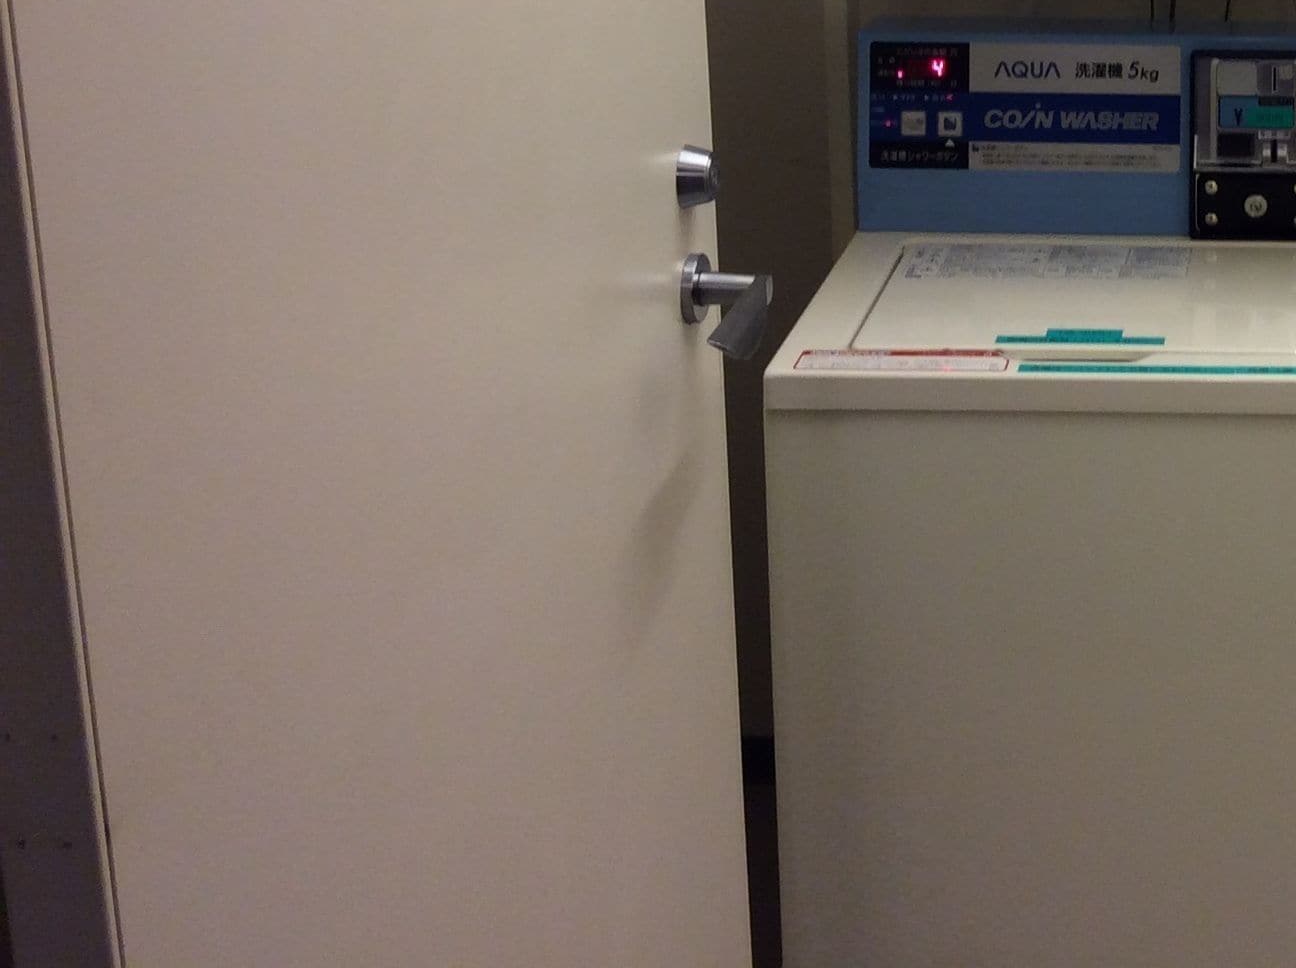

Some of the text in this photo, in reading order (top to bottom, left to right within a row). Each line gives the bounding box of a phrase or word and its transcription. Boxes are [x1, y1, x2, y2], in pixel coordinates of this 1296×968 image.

[931, 58, 946, 77] 4
[994, 60, 1159, 83] AQUA 洗濯機 5kg
[1059, 111, 1159, 131] WASHER
